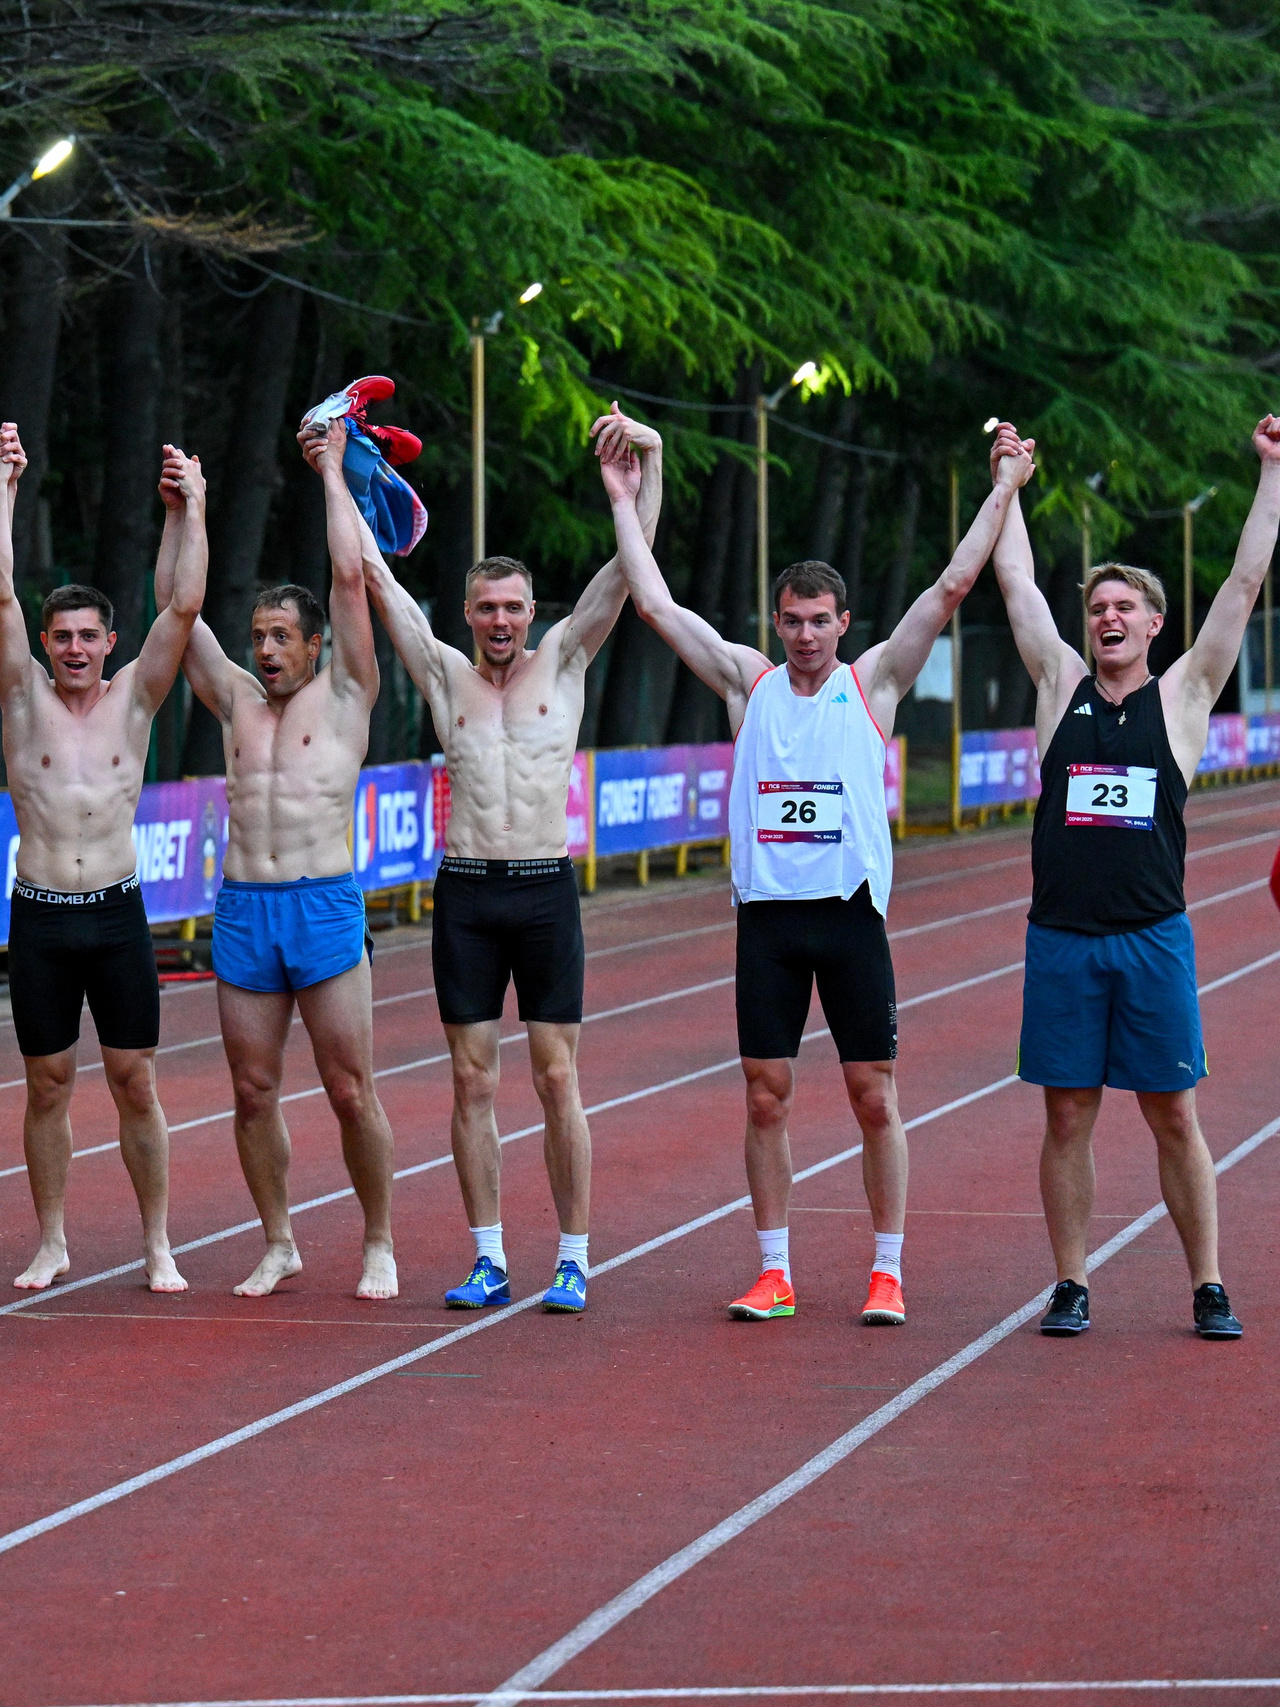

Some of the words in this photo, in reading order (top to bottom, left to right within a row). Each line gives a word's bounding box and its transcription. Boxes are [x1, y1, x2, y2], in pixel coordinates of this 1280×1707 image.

[1091, 783, 1128, 808] 23
[379, 789, 419, 854] ПСБ
[781, 800, 817, 824] 26
[131, 819, 192, 884] NBET
[14, 883, 35, 899] PRO
[35, 890, 107, 905] COMBAT
[121, 877, 140, 894] PR
